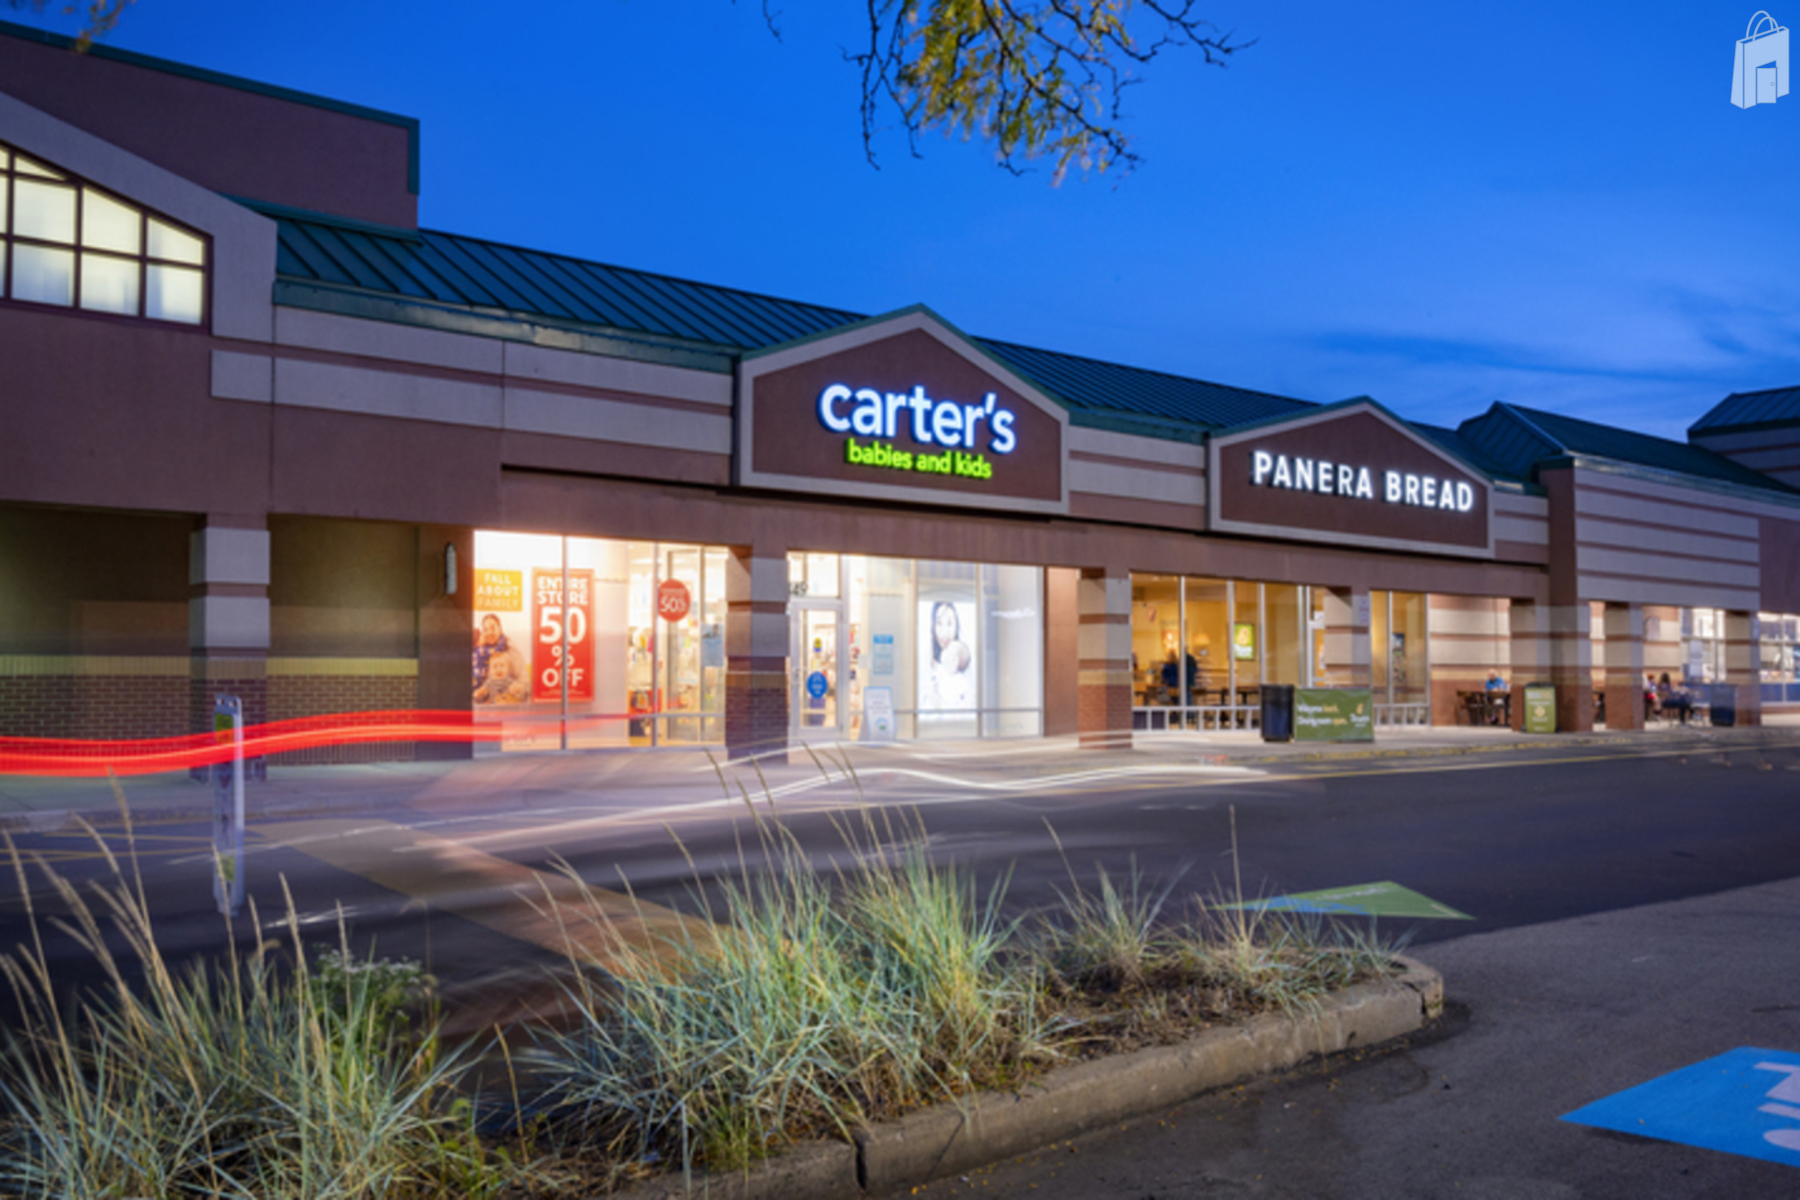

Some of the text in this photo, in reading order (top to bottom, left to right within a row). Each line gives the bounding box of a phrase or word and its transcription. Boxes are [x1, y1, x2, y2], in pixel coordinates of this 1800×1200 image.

[820, 383, 1016, 453] carter's
[848, 438, 992, 479] babies and kids
[1253, 450, 1474, 512] PANERA BREAD
[477, 585, 519, 597] ABOUT
[484, 573, 511, 585] FALL
[537, 576, 588, 591] ENTRE
[540, 606, 586, 643] 50
